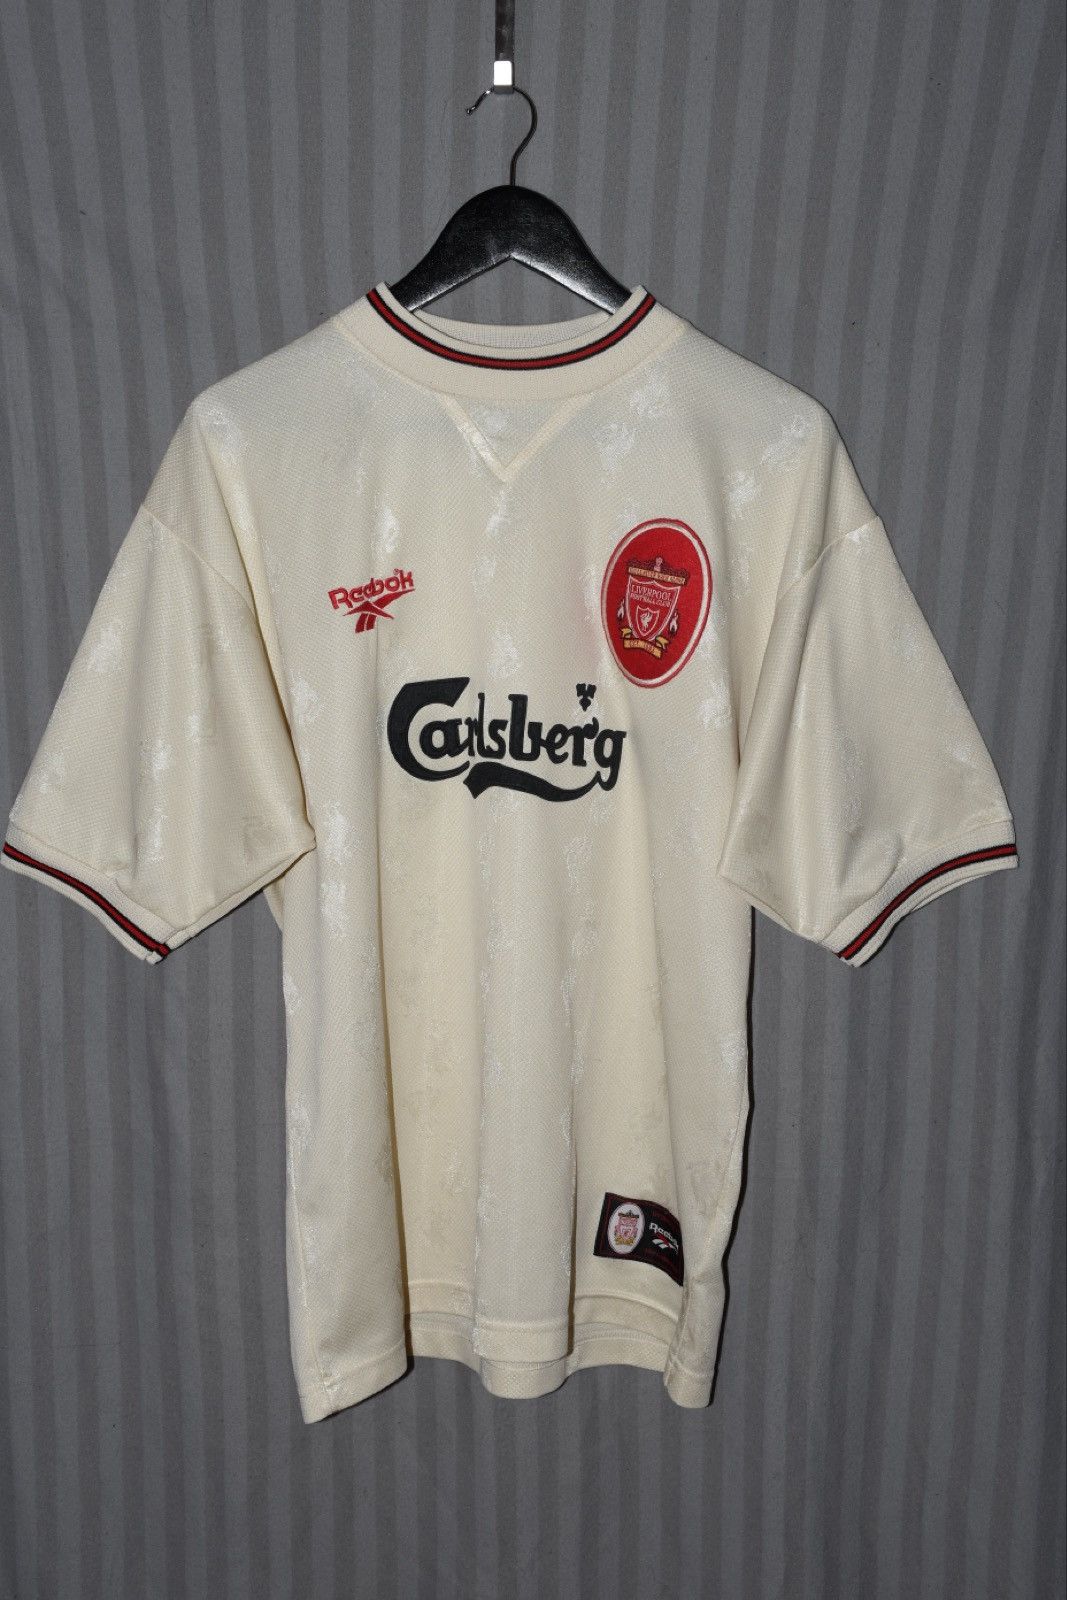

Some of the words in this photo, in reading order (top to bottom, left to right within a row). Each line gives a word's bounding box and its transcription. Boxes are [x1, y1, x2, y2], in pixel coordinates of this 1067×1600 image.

[328, 570, 414, 609] Reebok
[631, 585, 672, 601] LIVERPOOL
[387, 676, 627, 802] Carlsberg
